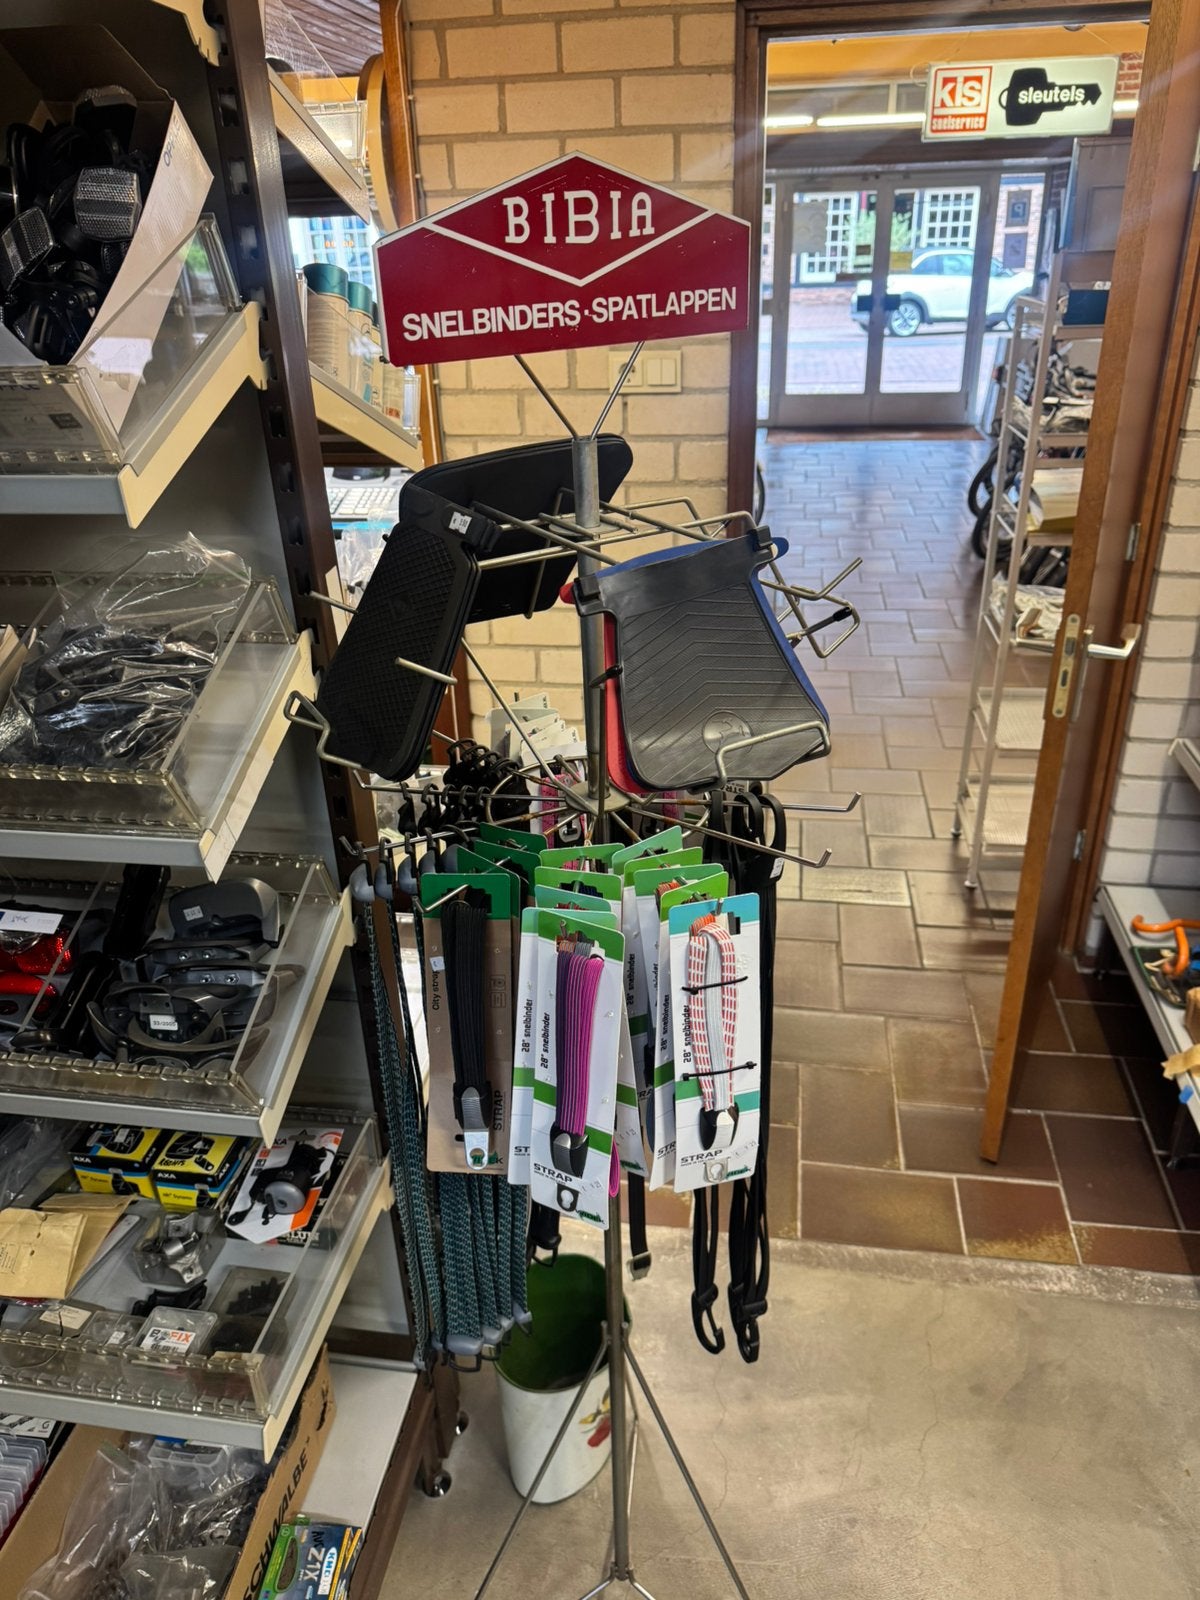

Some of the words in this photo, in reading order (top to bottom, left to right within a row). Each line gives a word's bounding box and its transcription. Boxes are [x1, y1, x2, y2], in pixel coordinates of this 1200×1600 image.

[1018, 86, 1085, 105] sleutels
[502, 190, 655, 245] BIBIA
[402, 300, 581, 342] SNELBINDERS
[591, 286, 737, 324] SPATLAPPEN
[432, 993, 442, 1011] City
[661, 994, 670, 1035] snelbinder
[523, 998, 533, 1038] snelbinder
[541, 1012, 550, 1054] snelbinder
[493, 1090, 503, 1131] STRAP
[73, 1155, 92, 1164] AXA
[681, 1149, 723, 1163] STRAP
[157, 1172, 177, 1180] AXA
[533, 1163, 573, 1183] STRAP
